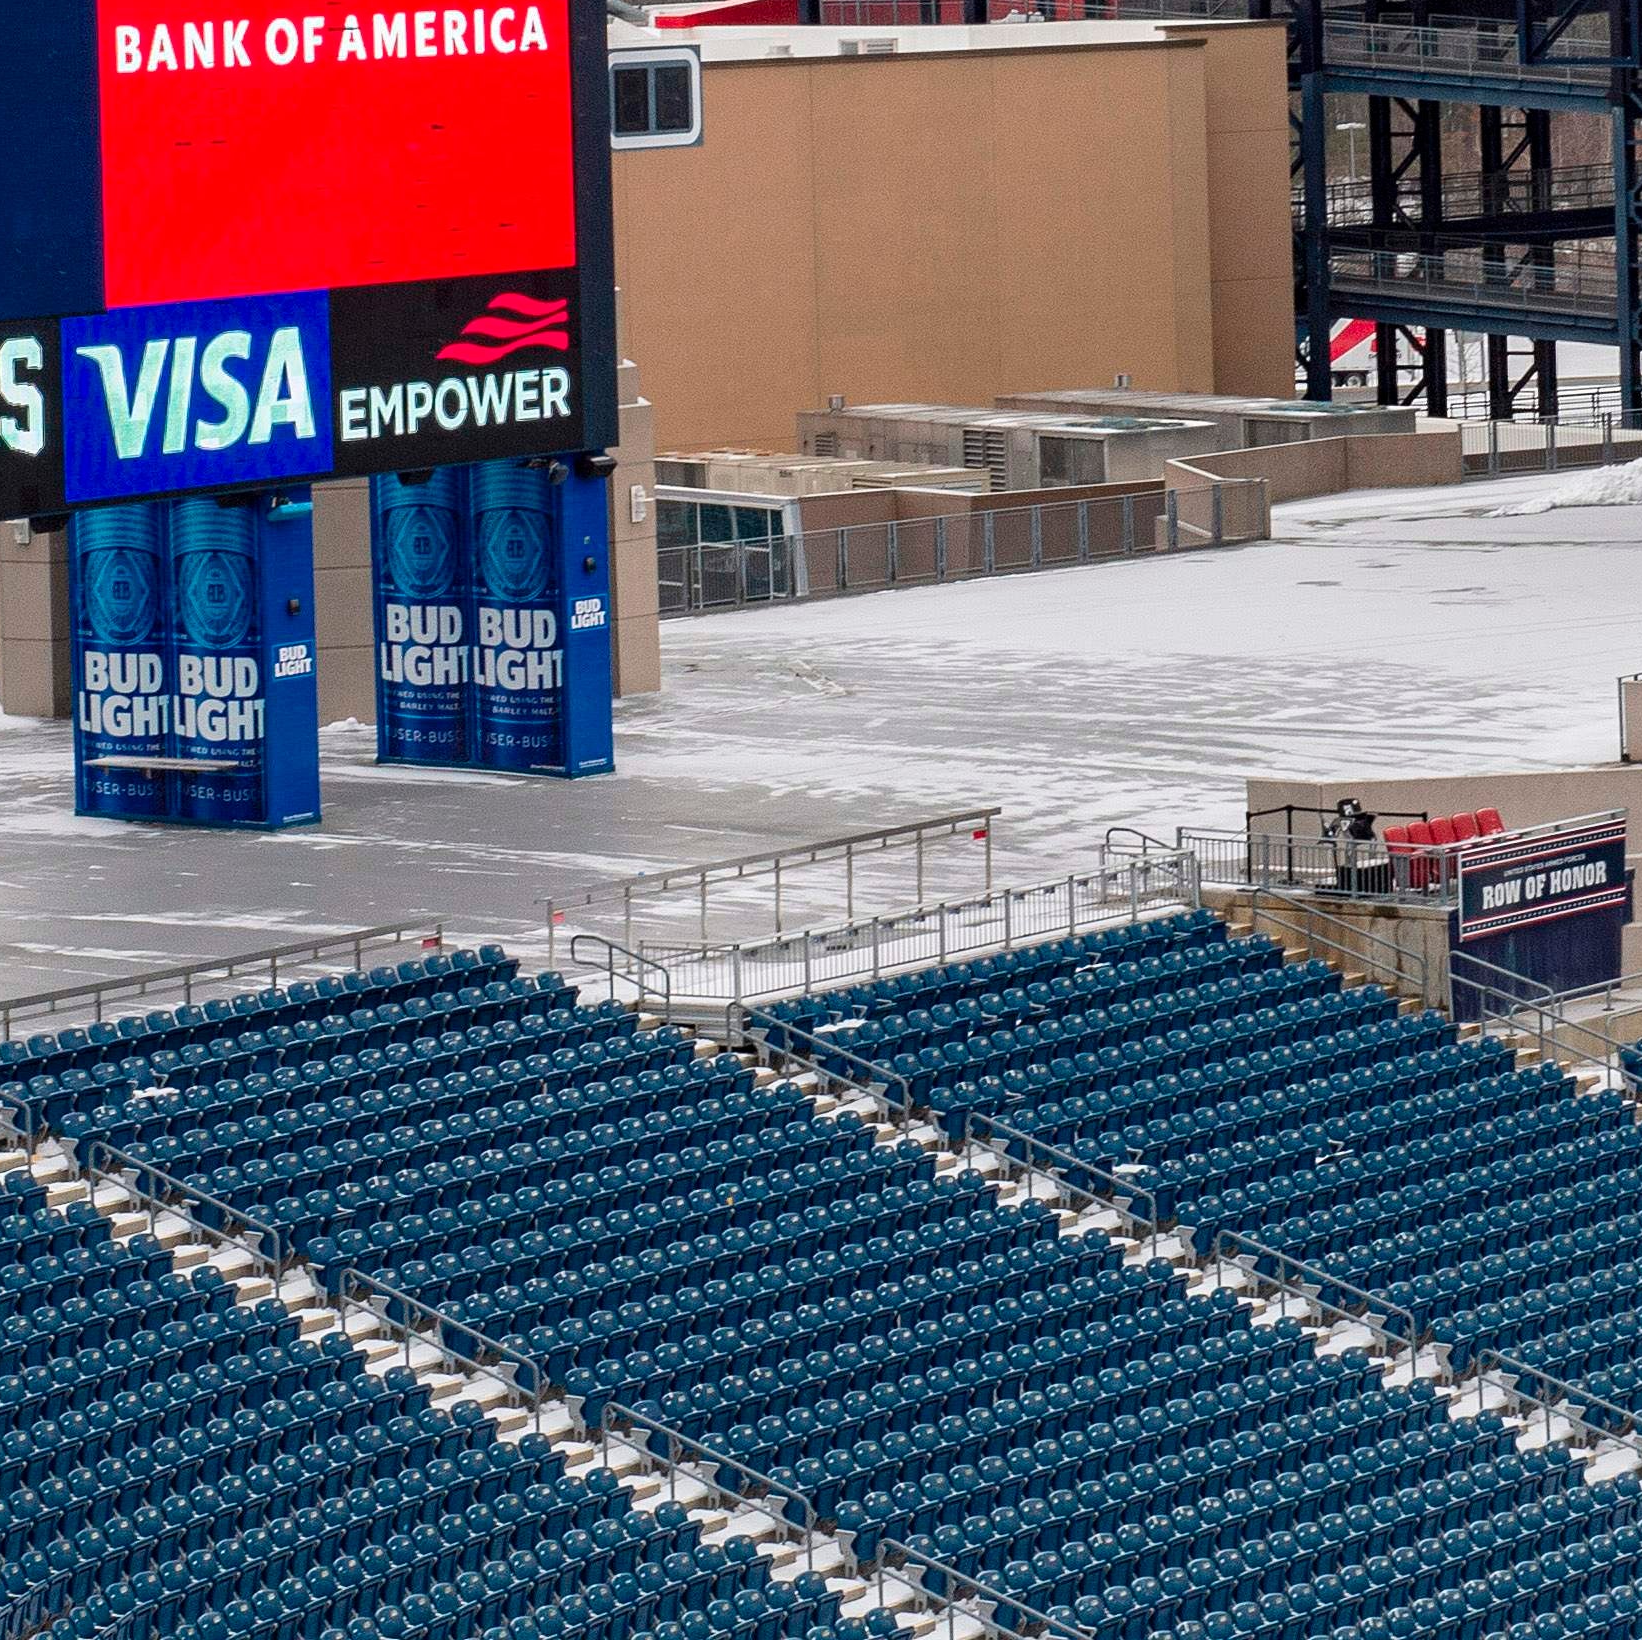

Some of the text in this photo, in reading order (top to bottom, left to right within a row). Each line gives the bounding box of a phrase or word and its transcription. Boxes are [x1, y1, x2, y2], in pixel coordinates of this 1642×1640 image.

[115, 6, 549, 73] BANK OF AMERICA
[76, 326, 317, 461] VISA
[340, 366, 571, 442] EMPOWER
[386, 604, 463, 646] BUD
[478, 607, 557, 649] BUD
[571, 611, 606, 630] LIGHT
[576, 599, 601, 614] BUD
[84, 651, 163, 694] BUD
[274, 657, 312, 678] LIGHT
[279, 644, 307, 662] BUD
[380, 642, 470, 685] LIGHT
[473, 646, 564, 690] LIGHT
[179, 654, 258, 698] BUD
[78, 691, 170, 737] LIGHT
[173, 695, 265, 741] LIGHT
[1482, 861, 1607, 910] ROW OF HONOR
